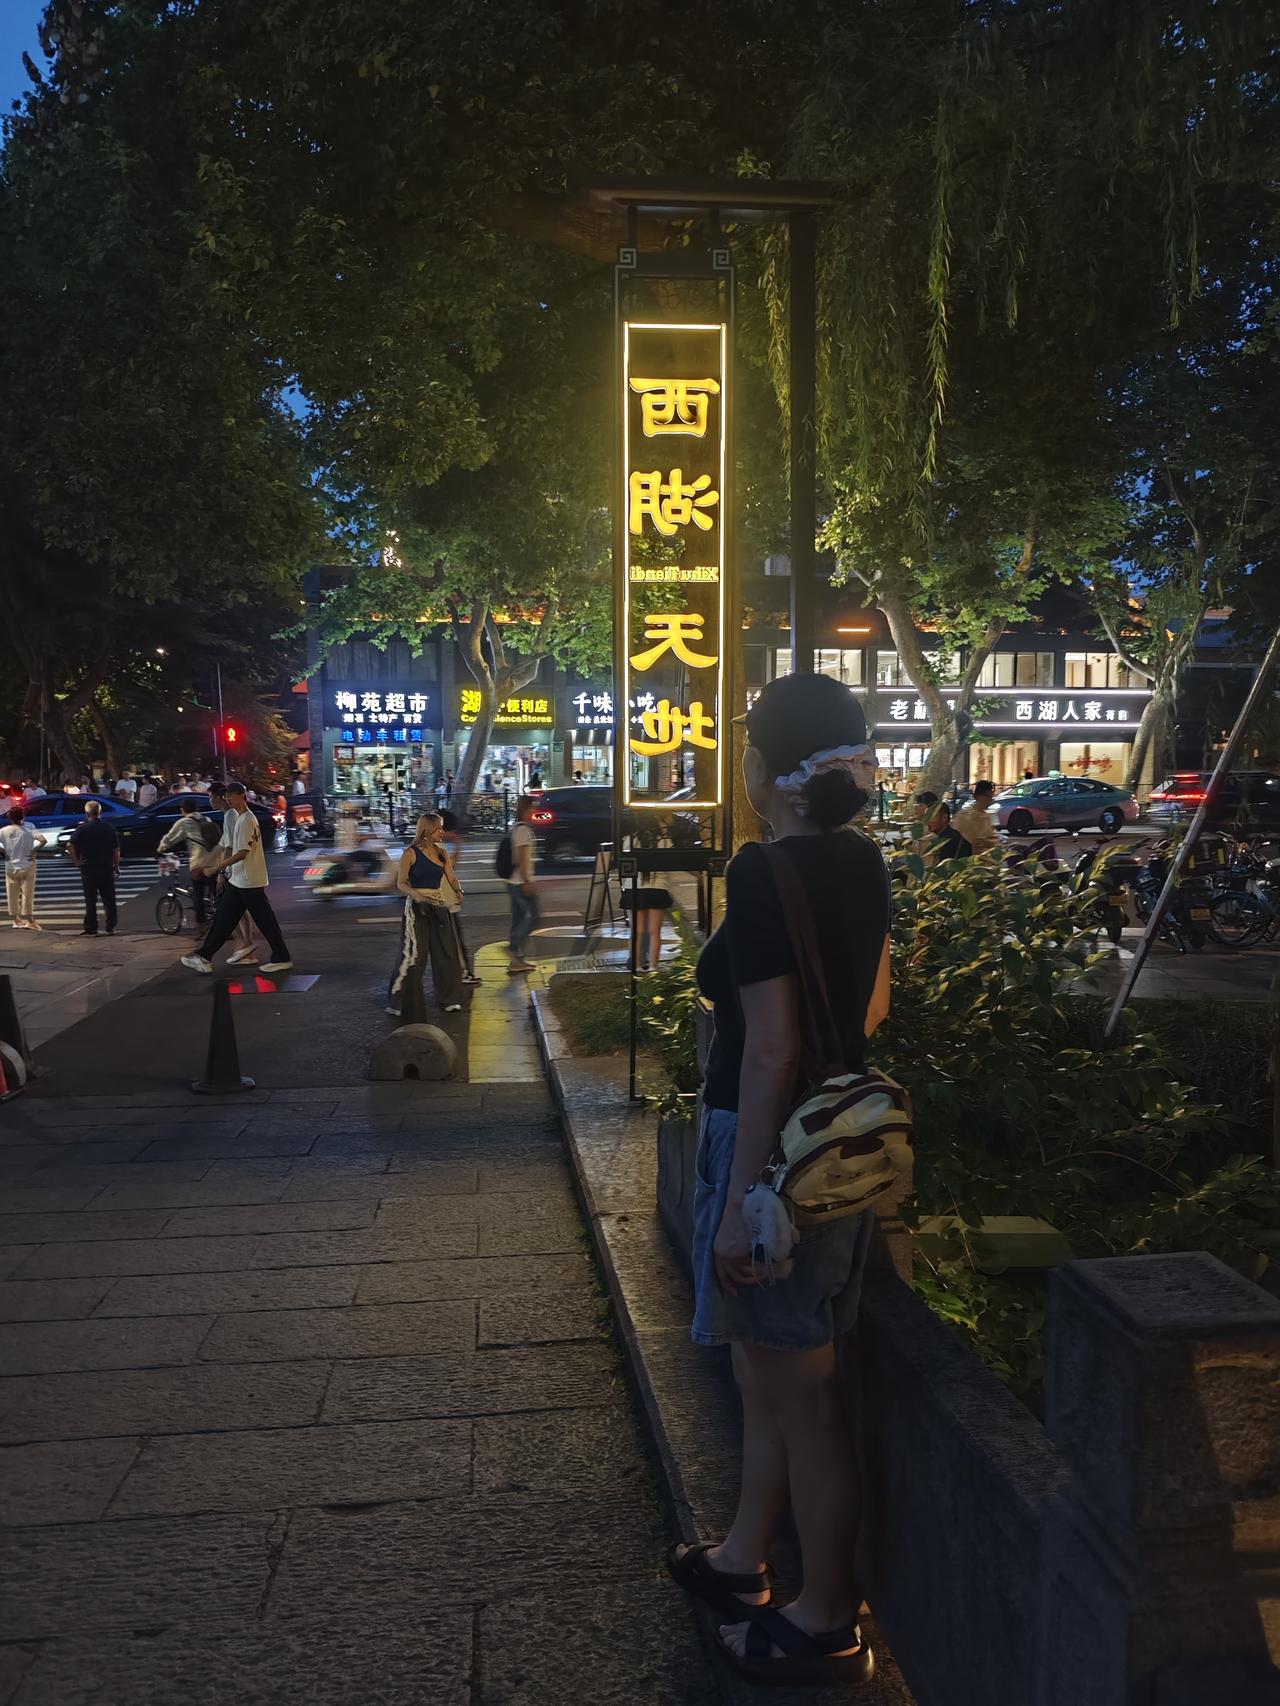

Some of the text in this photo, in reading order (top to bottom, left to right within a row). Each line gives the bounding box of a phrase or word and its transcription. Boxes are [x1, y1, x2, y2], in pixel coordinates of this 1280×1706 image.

[572, 692, 657, 714] 千味吃
[1016, 700, 1102, 721] 西湖人家
[343, 729, 422, 742] 电动车租赁
